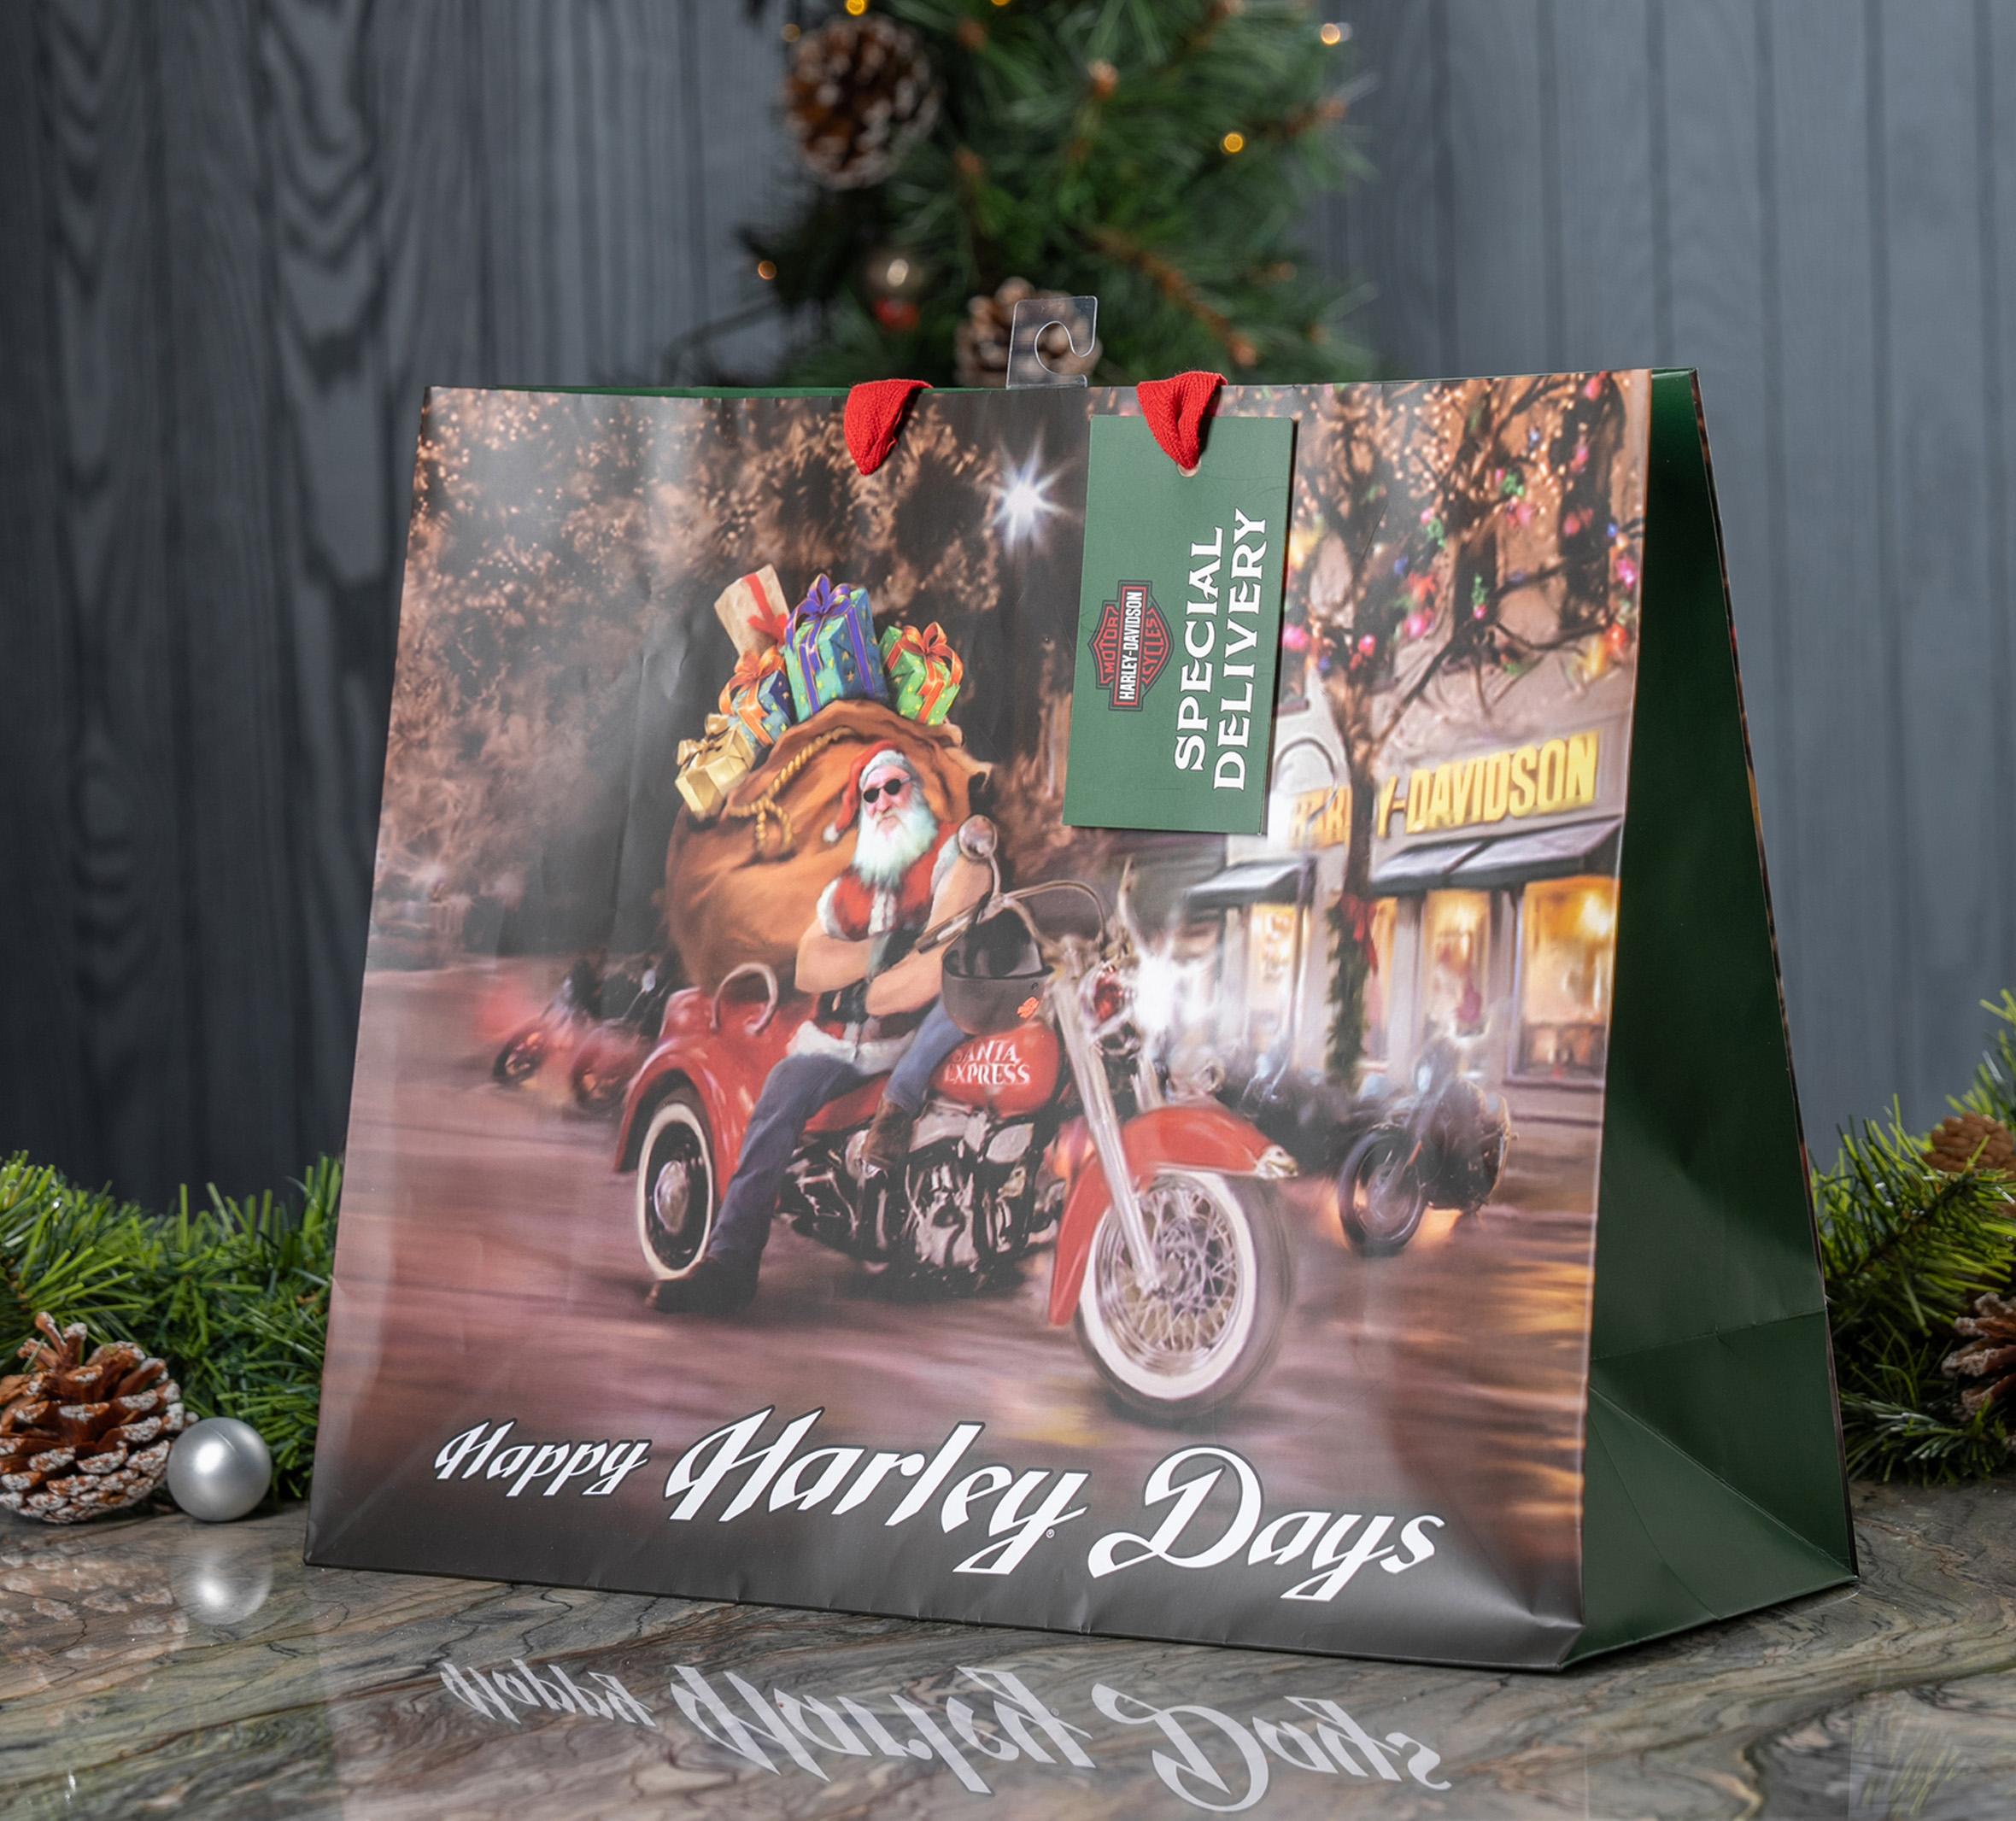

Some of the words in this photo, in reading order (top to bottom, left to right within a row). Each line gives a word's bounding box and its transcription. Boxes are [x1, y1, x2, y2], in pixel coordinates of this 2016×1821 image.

[1099, 617, 1119, 675] MOTOR
[1118, 591, 1143, 700] HARLEY-DAVIDSON
[1142, 618, 1165, 676] CYCLES
[1174, 526, 1224, 771] SPECIAL
[1212, 507, 1267, 791] DELIVERY
[943, 1063, 1031, 1085] EXPRESS
[952, 1039, 1018, 1064] SANTA
[434, 1420, 649, 1497] Happy
[665, 1408, 1089, 1576] Harley
[1087, 1447, 1445, 1602] Days
